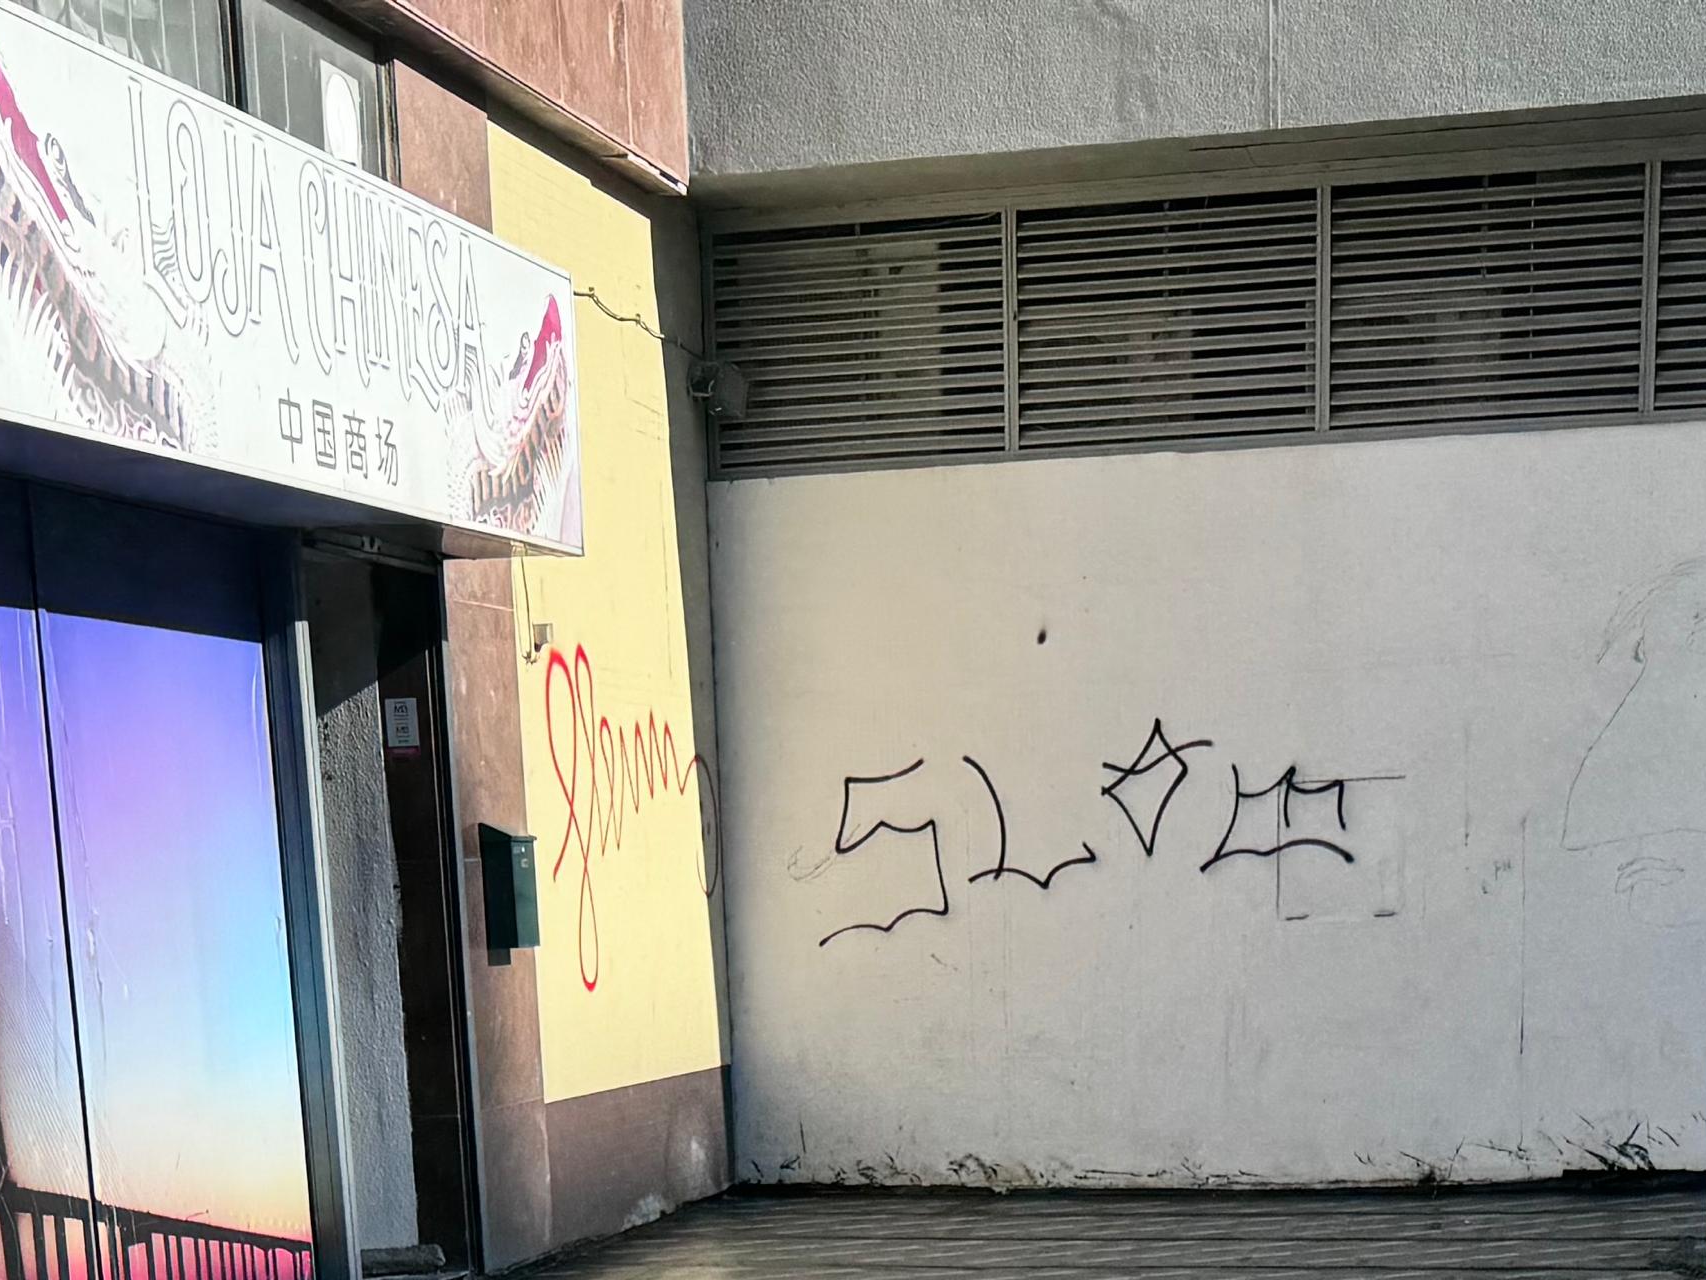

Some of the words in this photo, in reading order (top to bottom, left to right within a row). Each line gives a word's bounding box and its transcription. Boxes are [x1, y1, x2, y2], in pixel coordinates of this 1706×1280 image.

[127, 75, 300, 365] LOJA
[300, 158, 495, 430] CHINESA
[278, 387, 399, 487] 中国商场
